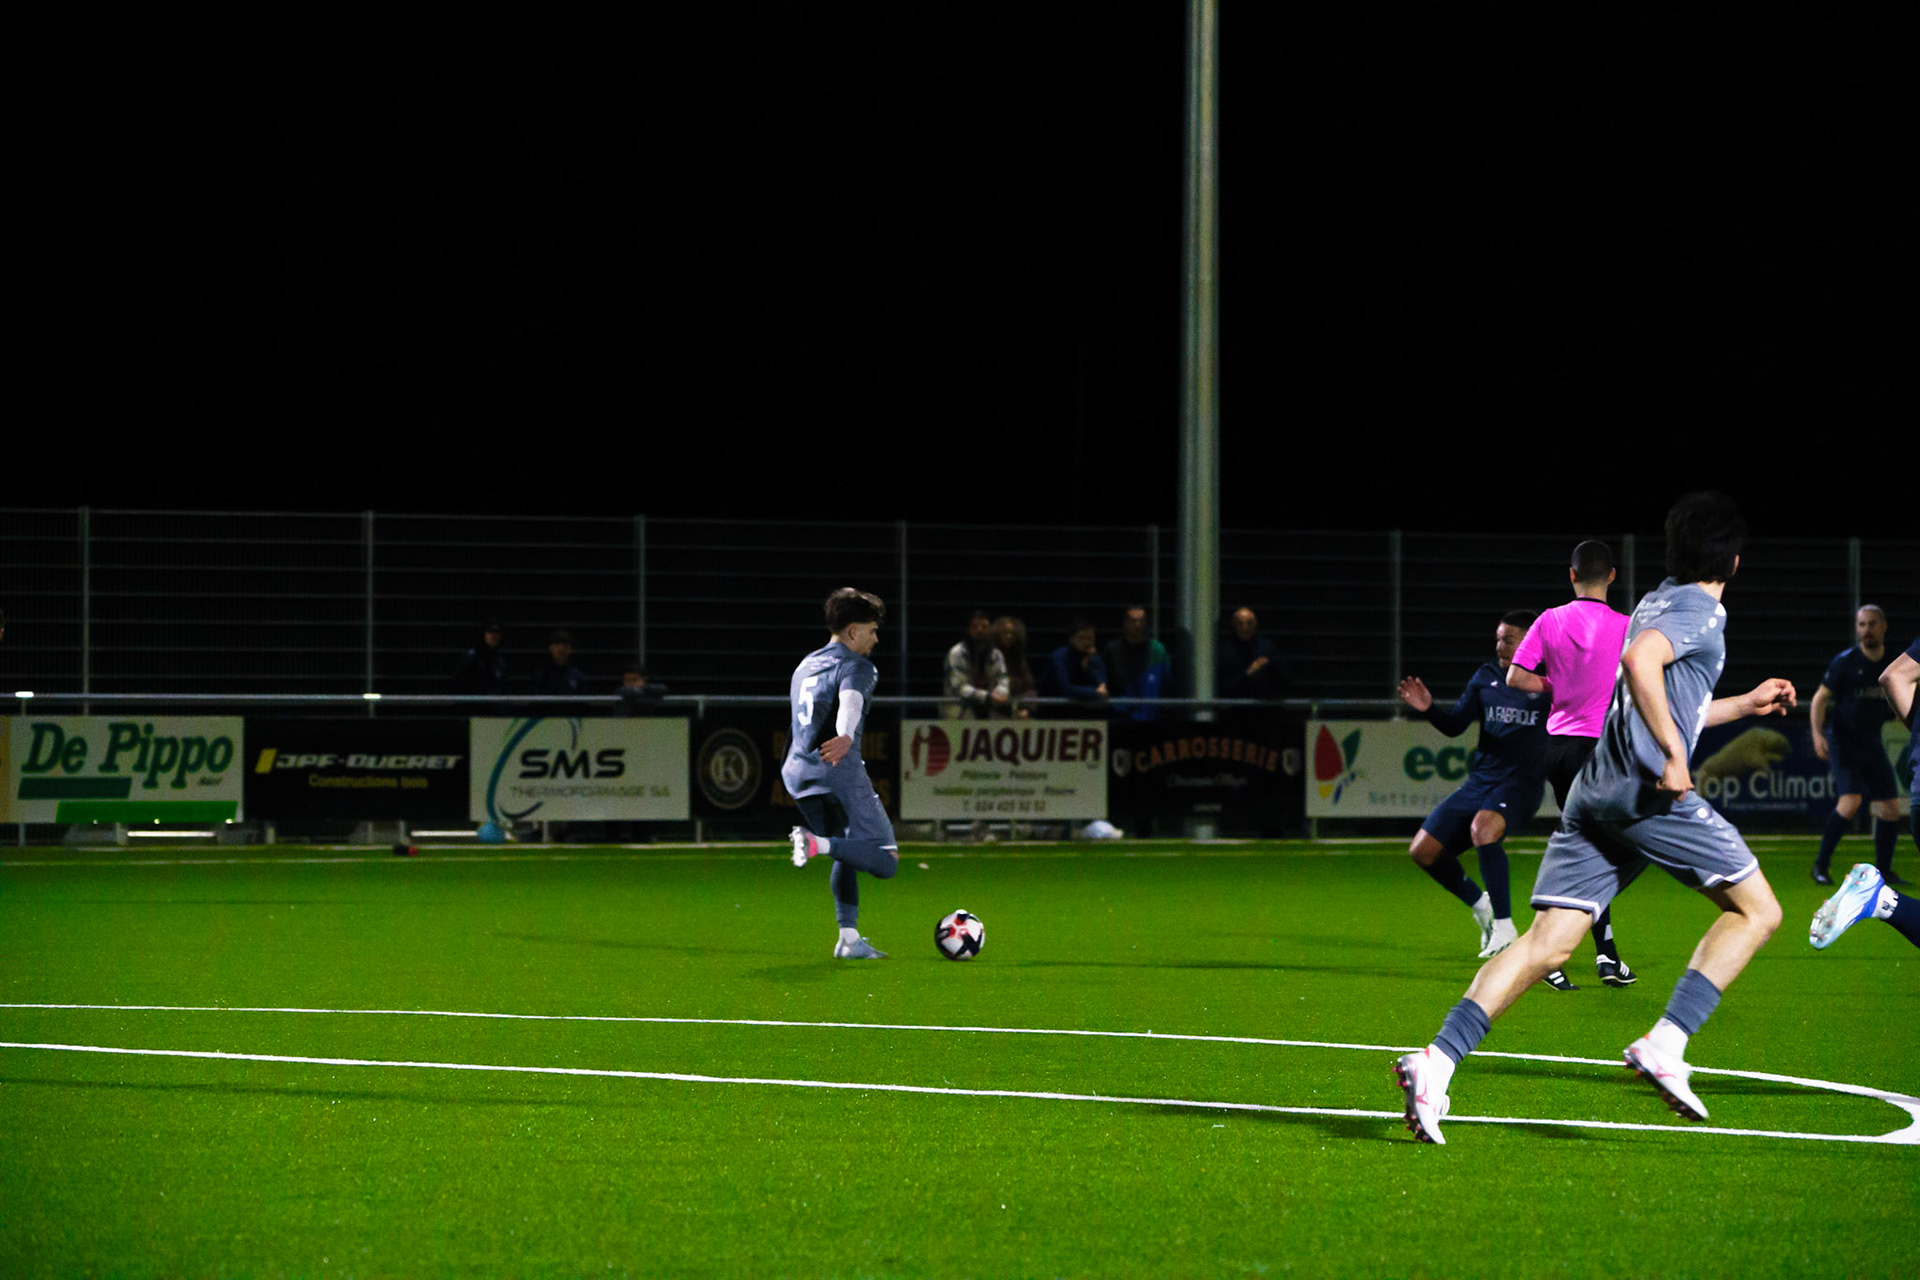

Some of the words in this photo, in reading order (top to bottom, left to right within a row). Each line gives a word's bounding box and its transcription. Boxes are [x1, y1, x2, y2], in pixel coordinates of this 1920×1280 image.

[797, 676, 819, 726] 5
[21, 723, 88, 773] De
[98, 723, 234, 789] Pippo
[519, 750, 625, 778] SMS
[956, 728, 1102, 765] JAQUIER
[1135, 737, 1279, 773] CARROSSERIE
[308, 773, 398, 788] Constructions
[1749, 769, 1836, 799] Climat
